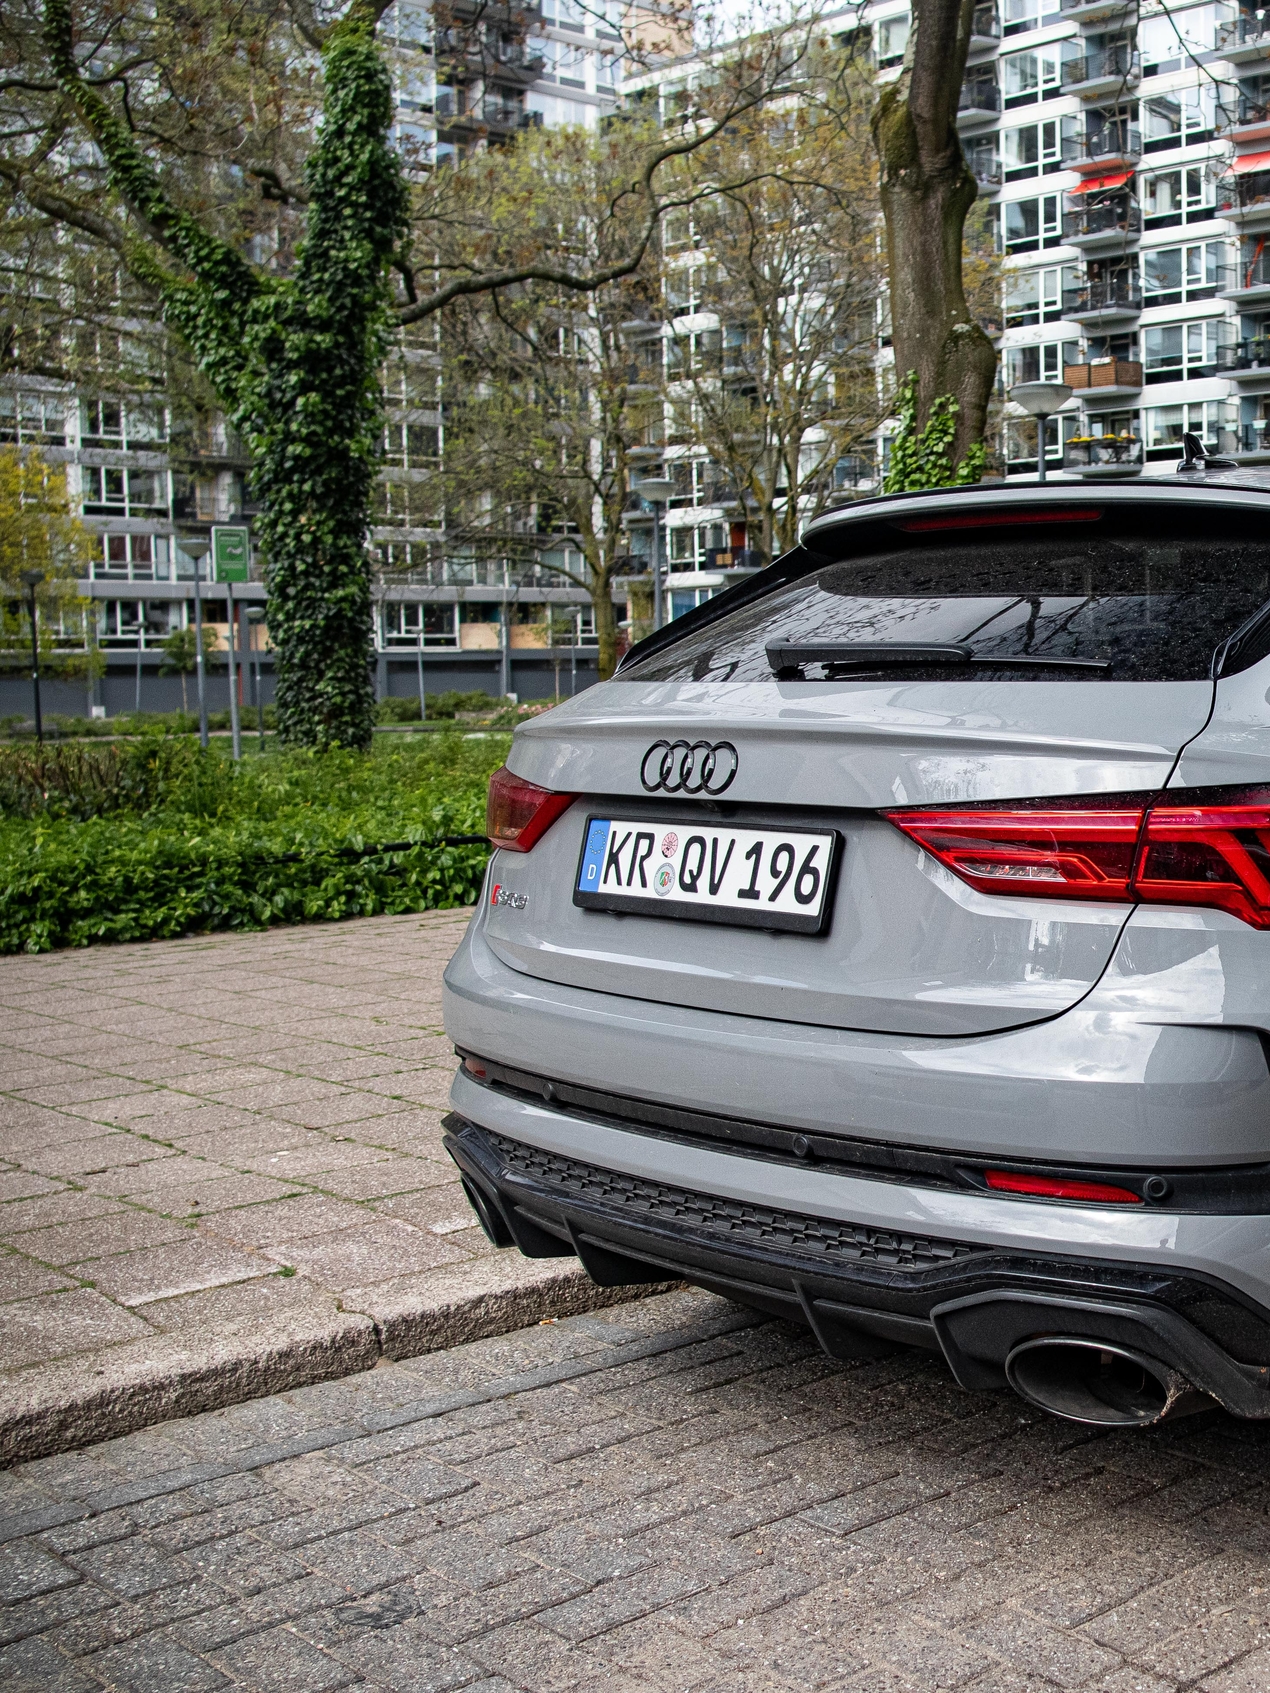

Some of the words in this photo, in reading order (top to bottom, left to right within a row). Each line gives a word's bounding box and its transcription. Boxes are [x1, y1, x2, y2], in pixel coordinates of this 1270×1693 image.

[587, 864, 597, 880] D
[603, 831, 655, 888] KR
[679, 835, 736, 896] QV
[737, 841, 820, 905] 196
